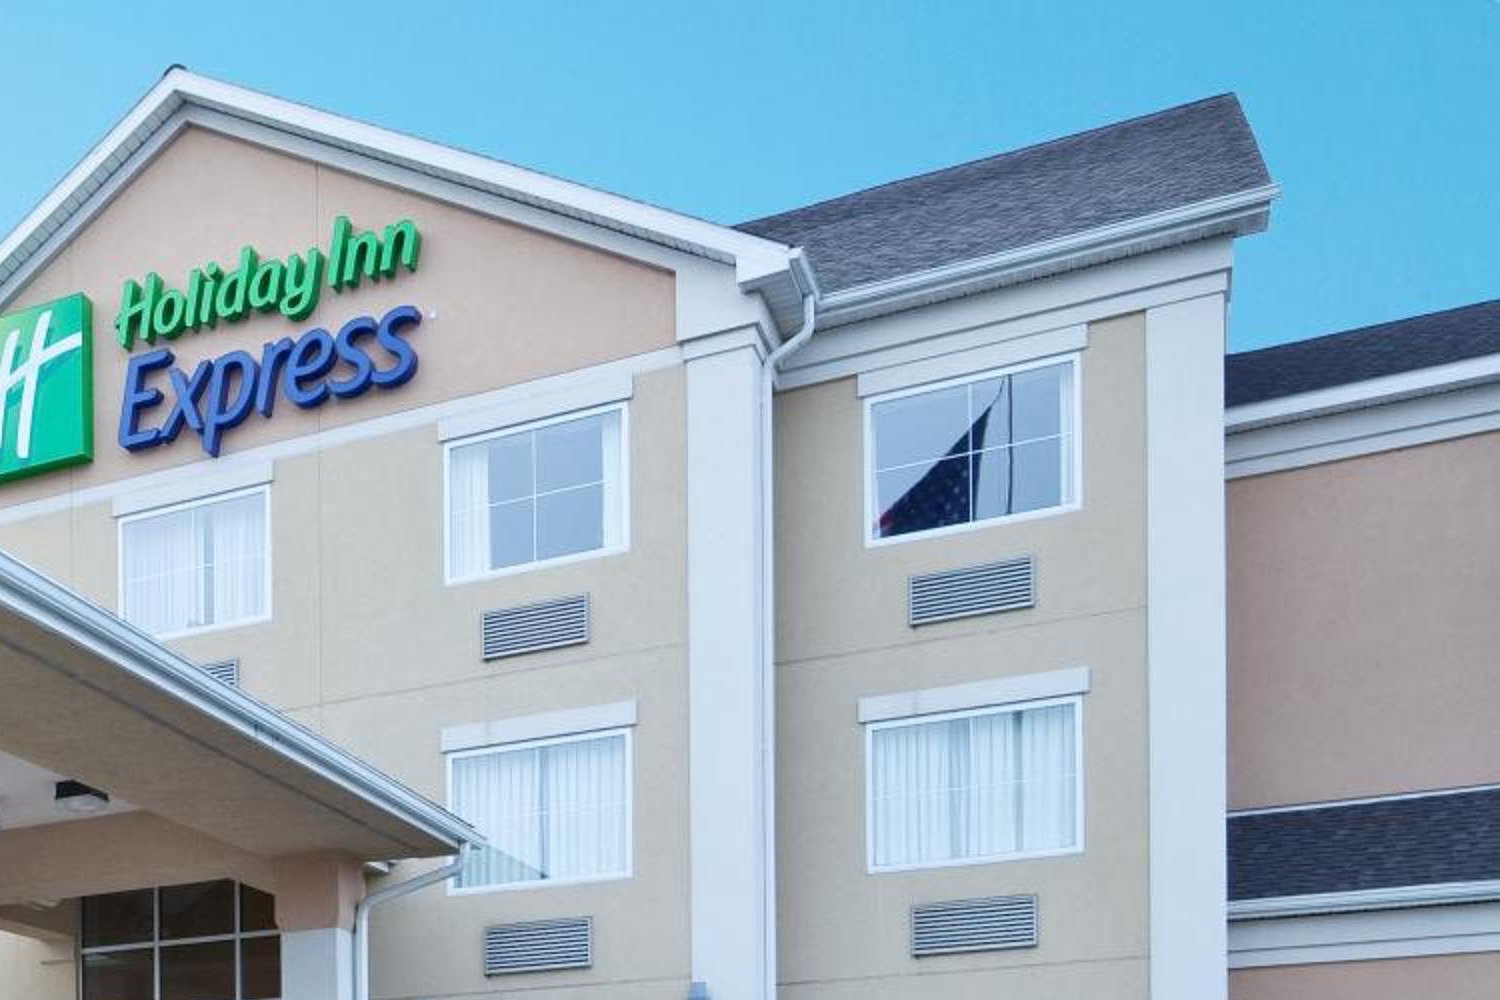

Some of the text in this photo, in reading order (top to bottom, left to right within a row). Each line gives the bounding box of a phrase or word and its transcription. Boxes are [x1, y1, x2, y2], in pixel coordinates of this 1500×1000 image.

[115, 215, 421, 351] Holiday Inn
[117, 305, 422, 458] Express
